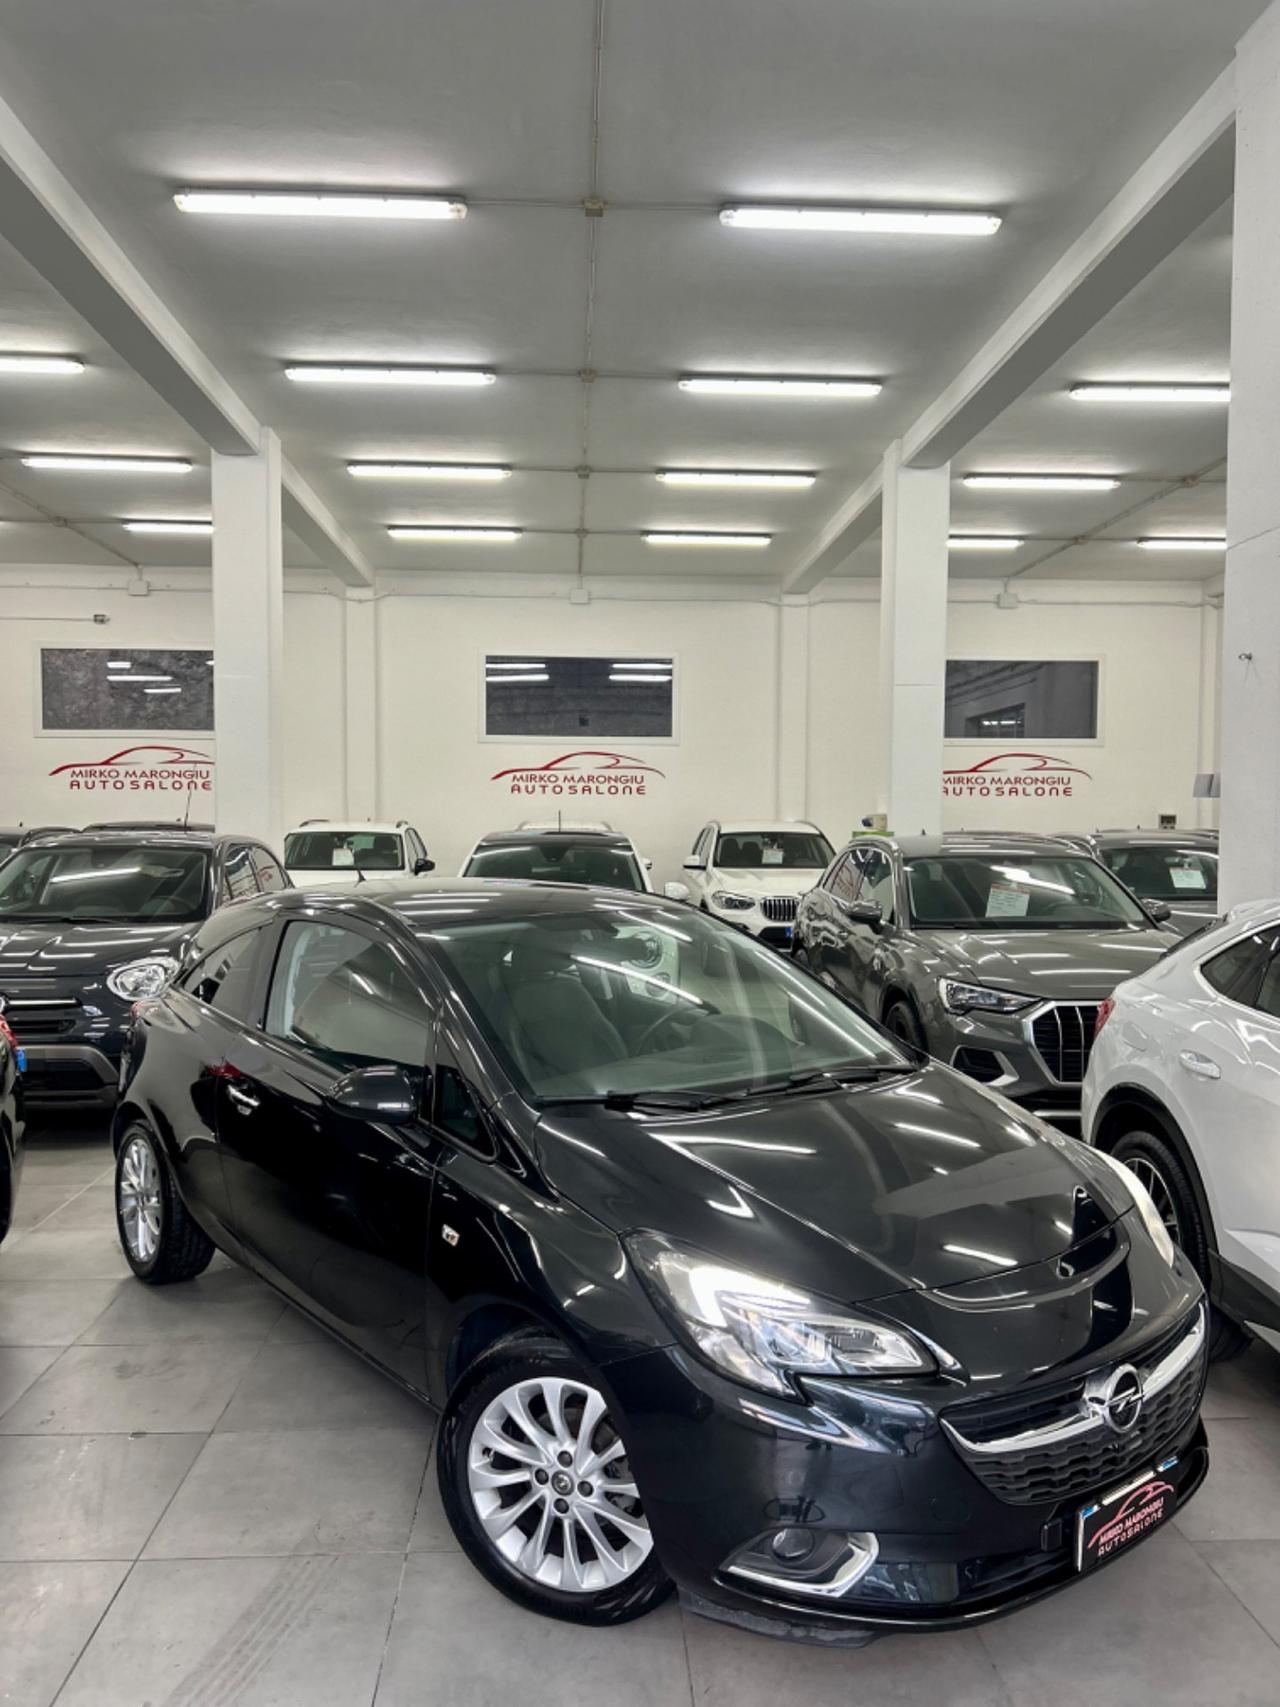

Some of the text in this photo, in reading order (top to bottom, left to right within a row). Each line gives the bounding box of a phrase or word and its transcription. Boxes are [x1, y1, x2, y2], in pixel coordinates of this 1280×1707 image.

[70, 769, 210, 780] MIRKO MARONGIU
[512, 773, 644, 784] MIRKO MARONGIU
[69, 780, 212, 790] AUTOSALONE
[990, 776, 1071, 786] MARONGIU
[511, 784, 646, 795] AUTOSALONE
